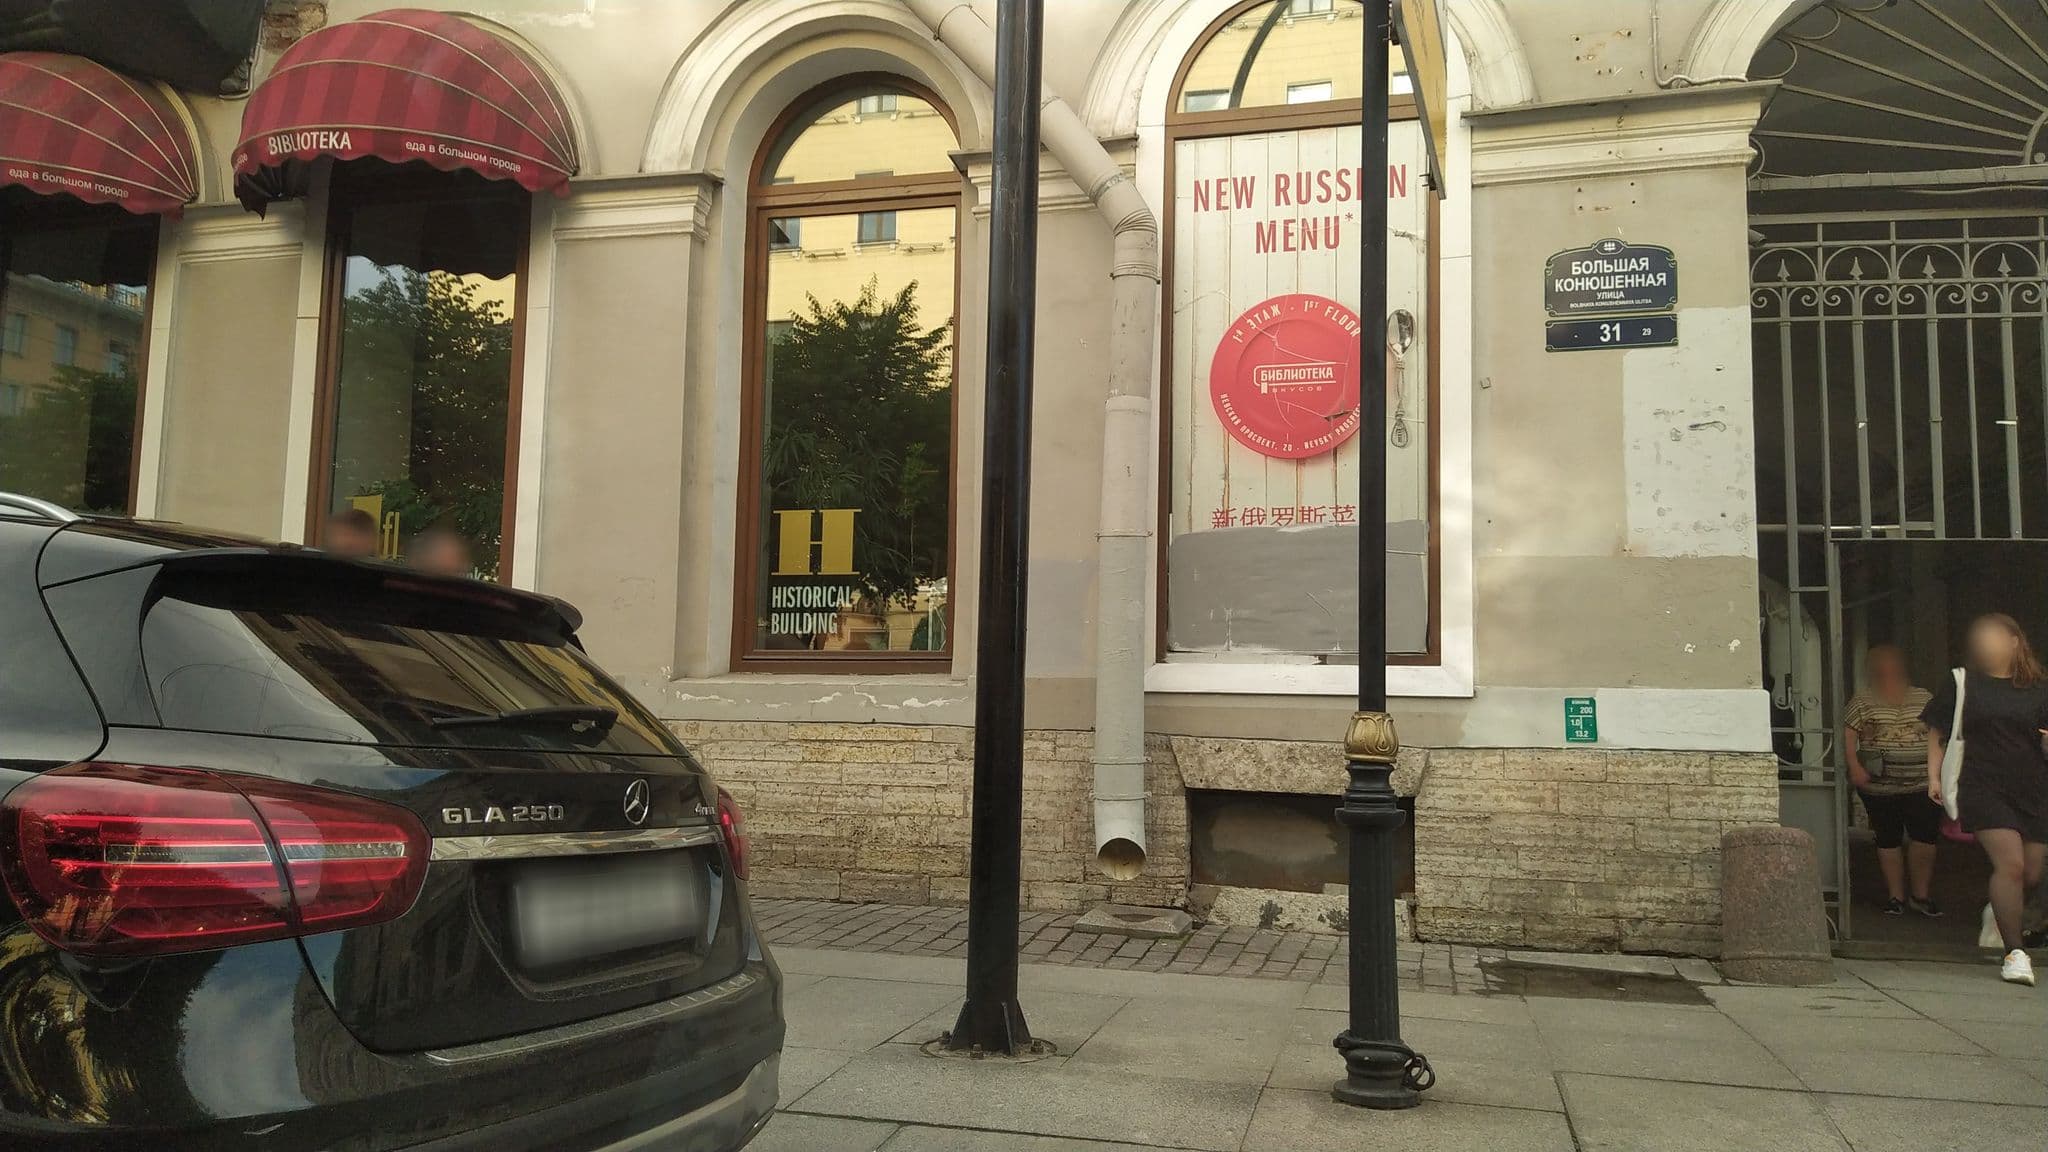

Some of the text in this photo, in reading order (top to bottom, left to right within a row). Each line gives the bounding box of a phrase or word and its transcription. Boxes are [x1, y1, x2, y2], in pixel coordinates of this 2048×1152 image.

[268, 131, 352, 155] BIBLIOTEKA
[405, 141, 521, 173] еда в большом городе
[9, 168, 129, 198] еда в большом городе
[1194, 164, 1406, 212] NEW RUSSIN
[1571, 257, 1649, 275] БОЛЬШАЯ
[1555, 273, 1667, 292] КОНЮШЕННАЯ
[1596, 291, 1625, 300] УЛИЦА
[1599, 322, 1652, 342] 31 29
[1260, 367, 1334, 382] БИБЛИОТЕКА
[771, 508, 862, 575] H
[772, 586, 853, 608] HISTORICAL
[771, 612, 838, 634] BUILDING
[442, 805, 564, 824] GLA 250
